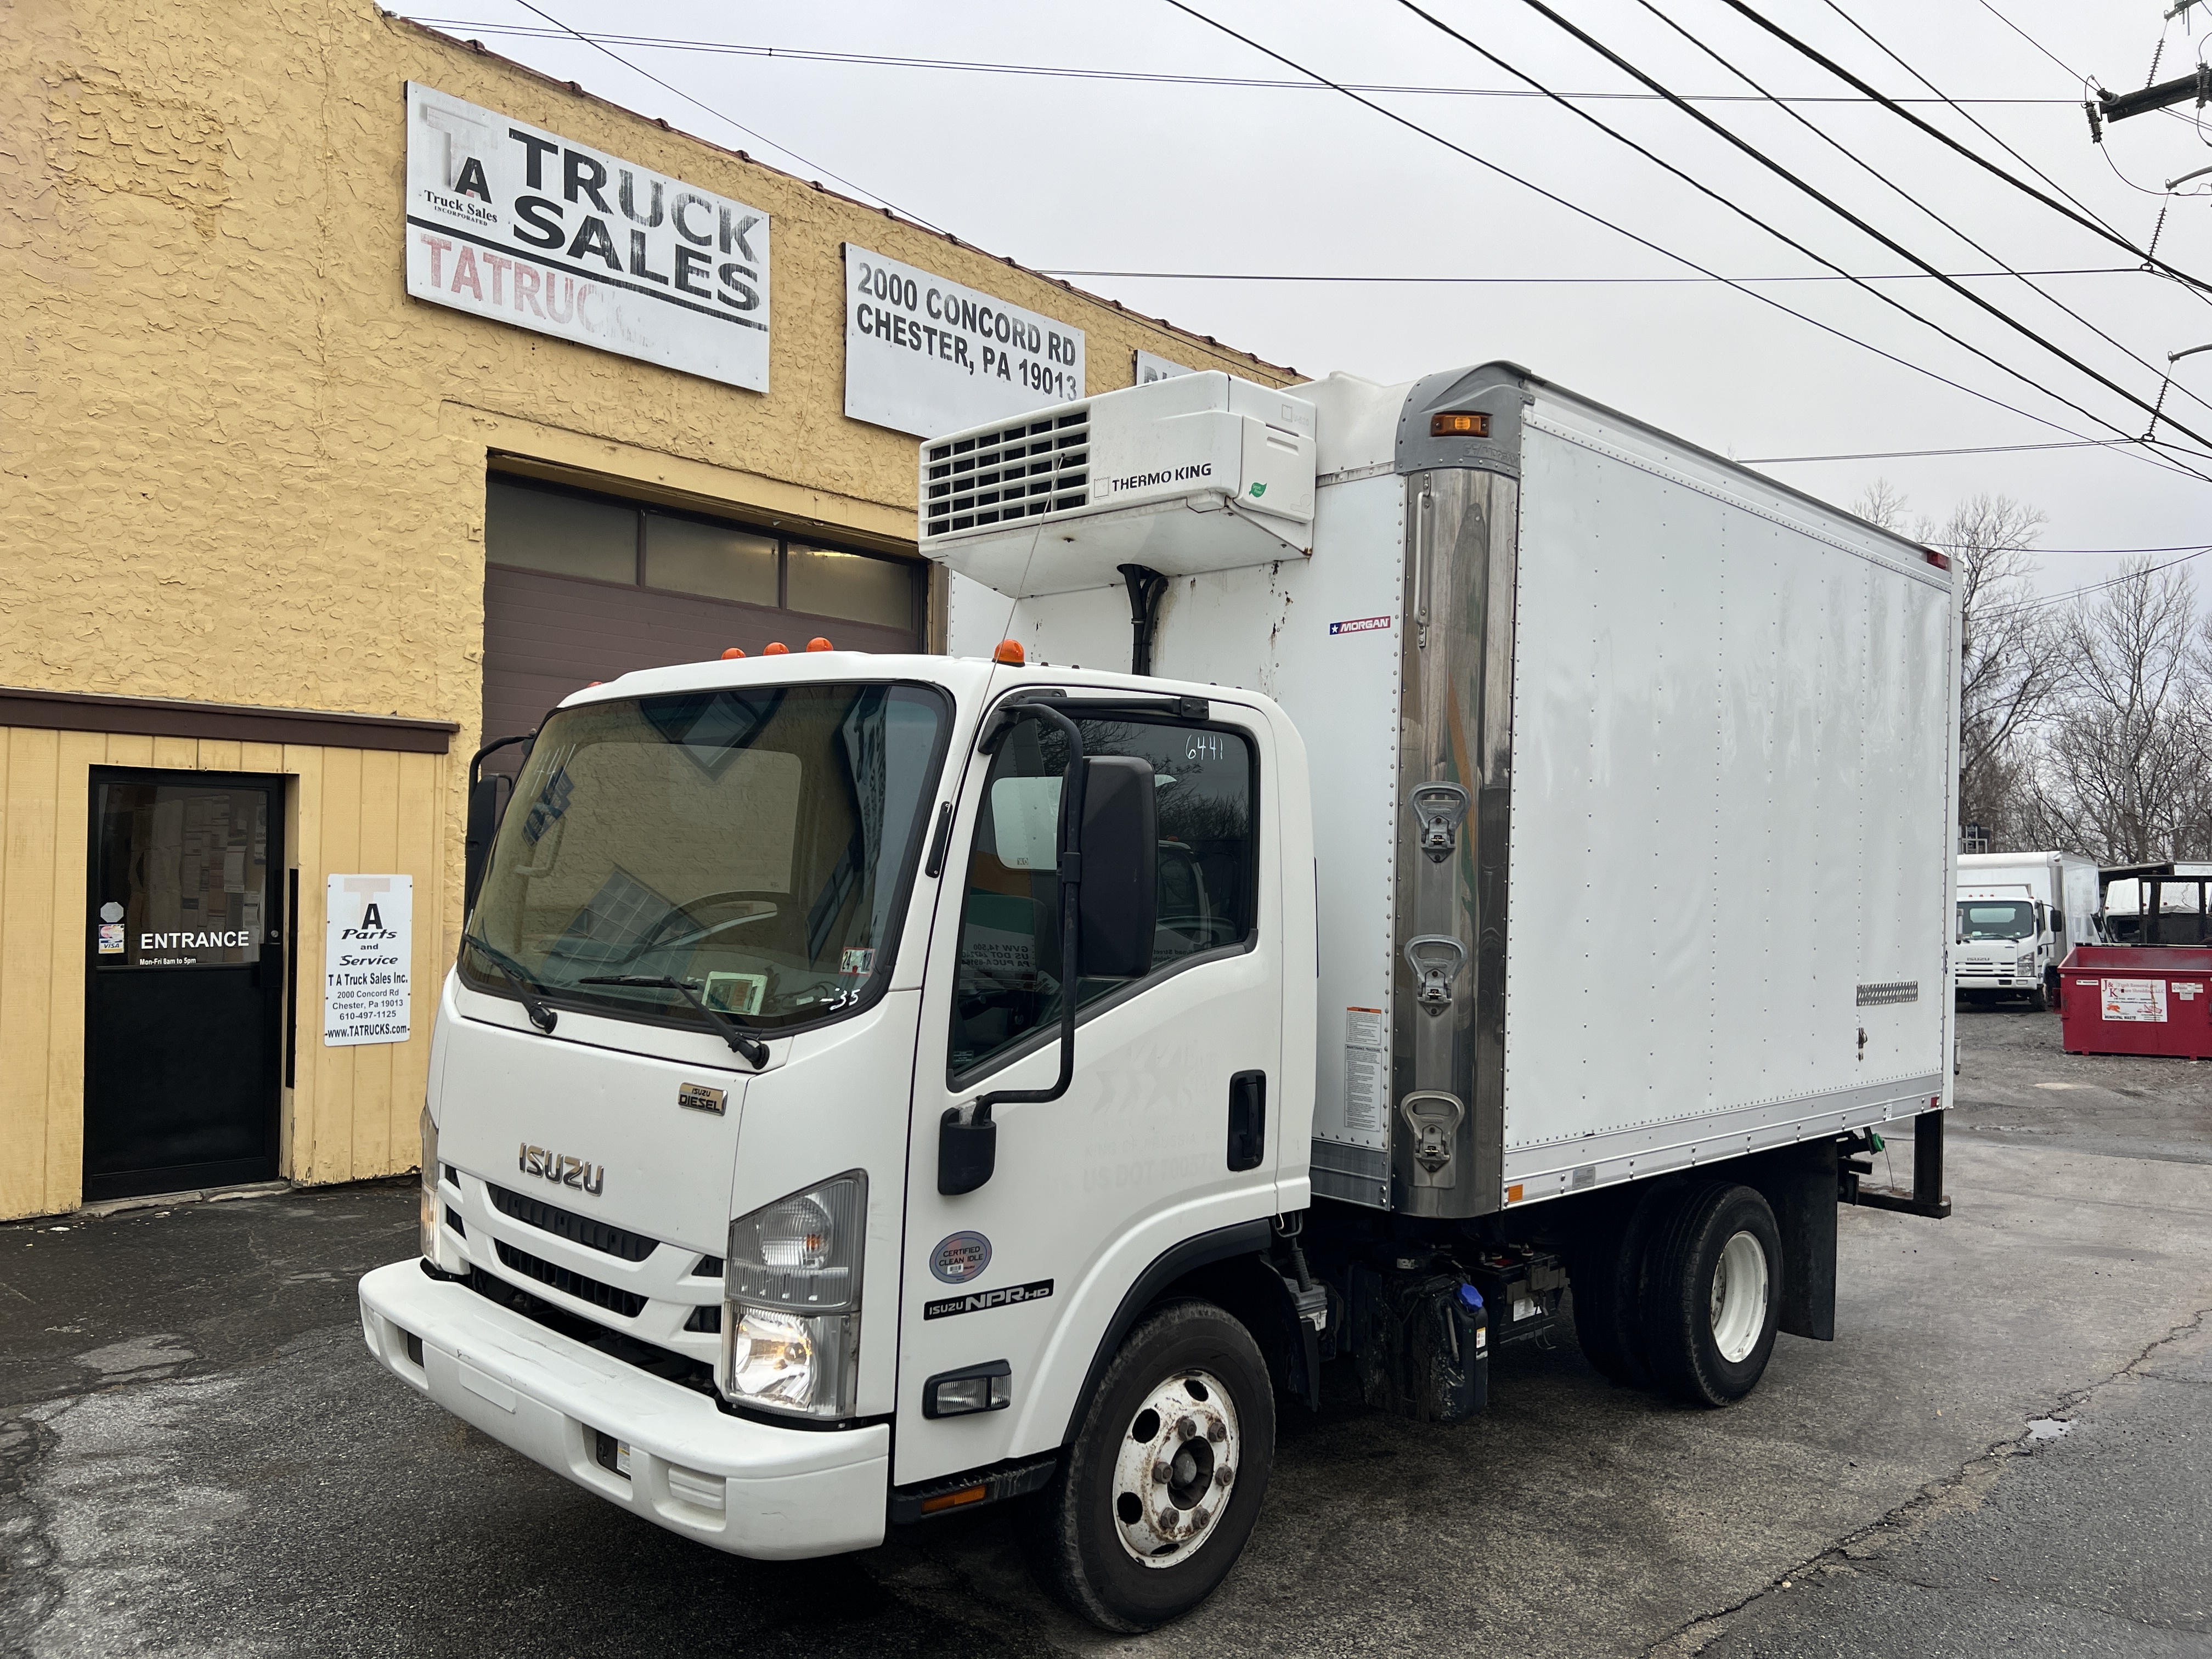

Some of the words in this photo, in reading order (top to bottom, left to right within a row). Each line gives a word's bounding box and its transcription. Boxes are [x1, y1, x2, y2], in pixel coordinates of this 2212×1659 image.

[508, 127, 760, 264] TRUCK
[424, 189, 464, 212] Truck
[467, 203, 498, 223] Sales
[434, 205, 488, 227] INCORPORATED
[512, 195, 760, 311] SALES
[857, 262, 918, 312] 2000
[926, 287, 1041, 354] CONCORD
[1047, 329, 1076, 367] RD
[856, 303, 974, 375] CHESTER,
[983, 346, 1012, 381] PA
[1018, 358, 1077, 402] 19013
[1112, 470, 1172, 492] THERMO
[1175, 462, 1212, 481] KING
[1340, 618, 1389, 633] MORGAN
[1185, 734, 1223, 761] 6441
[140, 931, 249, 949] ENTRANCE
[341, 929, 397, 940] Parts
[183, 957, 196, 966] 5pm
[339, 955, 398, 966] Service
[328, 974, 334, 986] T
[336, 974, 342, 986] A
[345, 973, 368, 986] Truck
[370, 972, 391, 985] Sales
[394, 972, 408, 984] Inc.
[337, 991, 354, 999] 2000
[357, 989, 387, 998] Concord
[332, 1002, 366, 1010] Chester,
[381, 999, 404, 1007] 19013
[340, 1010, 397, 1020] 610-497-1125
[328, 1023, 407, 1039] www.TATRUCKS.com
[692, 1088, 711, 1097] ISUZU
[680, 1094, 720, 1111] DIESEL
[519, 1142, 604, 1197] ISUZU
[943, 1246, 980, 1257] CERTIFIED
[939, 1257, 964, 1267] CLEAN
[967, 1254, 984, 1262] IDLE
[929, 1301, 963, 1316] ISUZU
[965, 1286, 1025, 1311] NPR
[1025, 1288, 1049, 1300] HD
